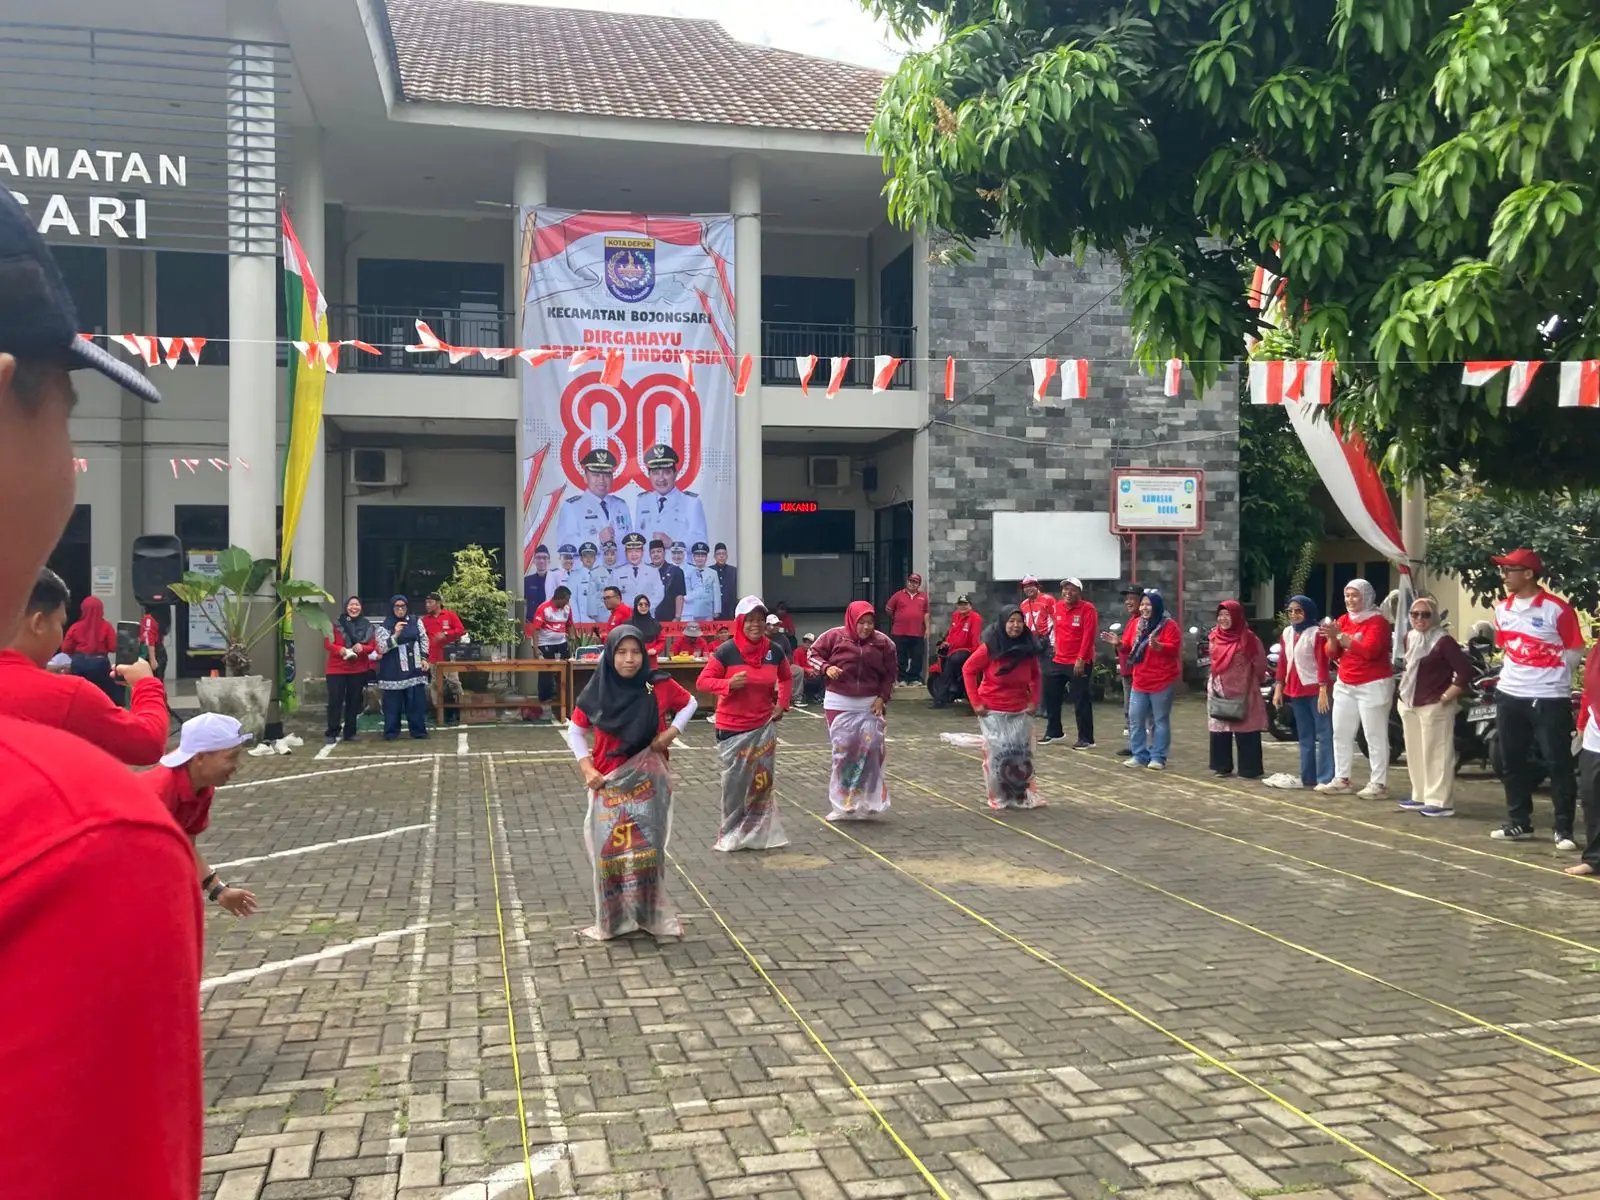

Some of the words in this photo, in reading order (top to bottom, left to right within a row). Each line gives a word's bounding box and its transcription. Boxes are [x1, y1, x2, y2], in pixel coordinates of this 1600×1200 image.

[0, 144, 187, 187] AMATAN
[9, 190, 147, 240] ARI
[608, 239, 627, 247] KOTA
[628, 240, 652, 248] DEPOK
[547, 307, 626, 322] KECAMATAN
[631, 310, 712, 324] BOJONGSARI
[583, 328, 682, 347] DIRGAHAYU
[560, 371, 701, 494] 80
